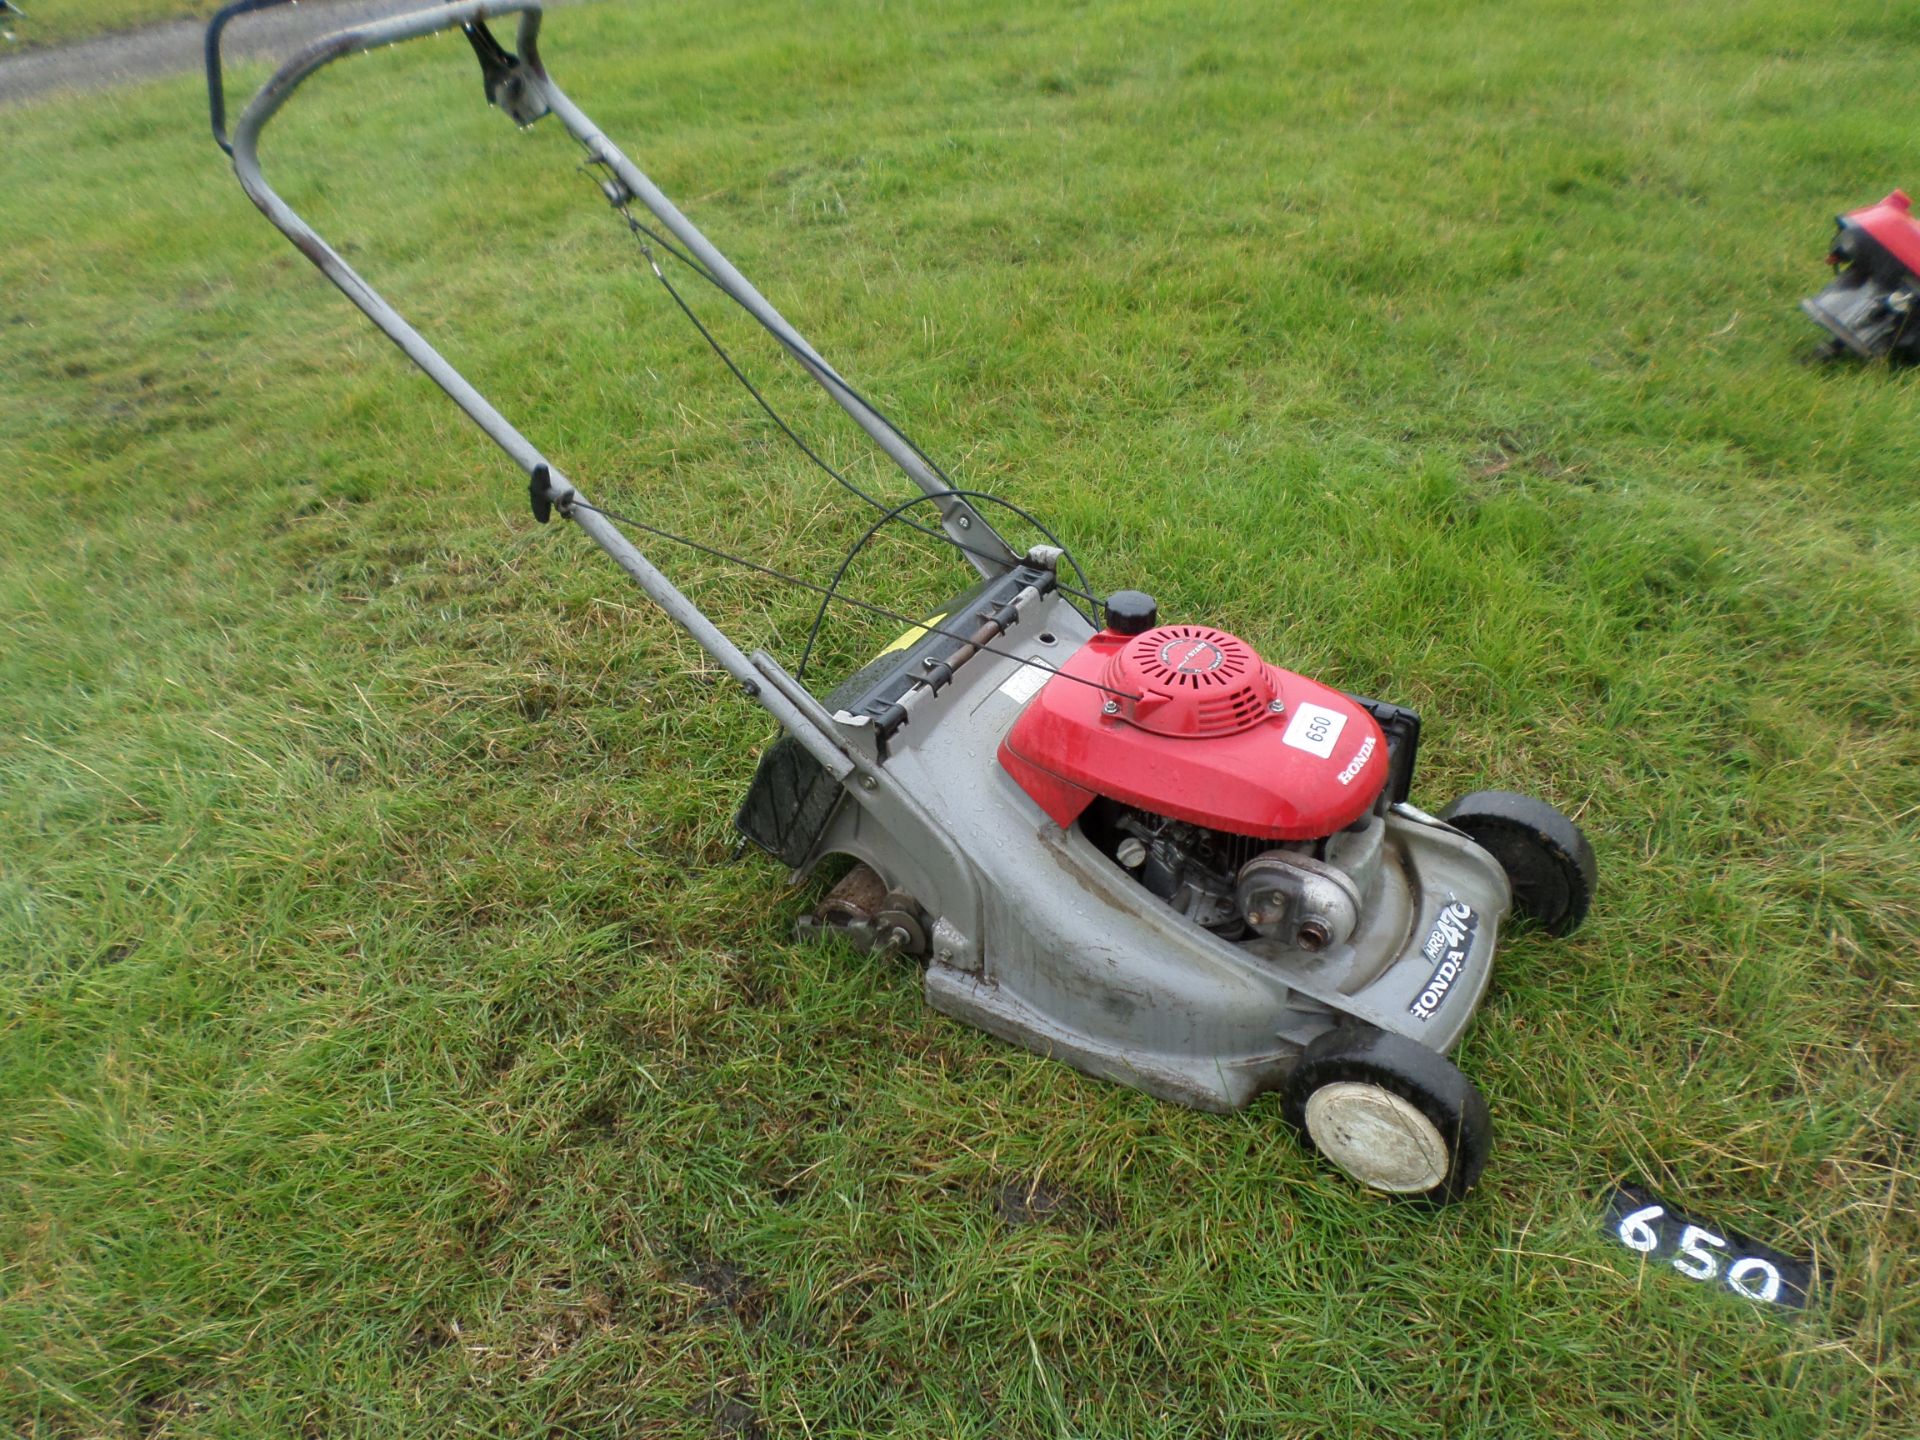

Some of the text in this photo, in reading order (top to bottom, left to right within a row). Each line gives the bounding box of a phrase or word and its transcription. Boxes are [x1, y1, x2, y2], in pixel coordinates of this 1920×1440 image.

[1305, 716, 1332, 742] 650
[1337, 736, 1377, 786] HONDA
[1410, 950, 1465, 1019] HONDA
[1619, 1205, 1780, 1303] 650
